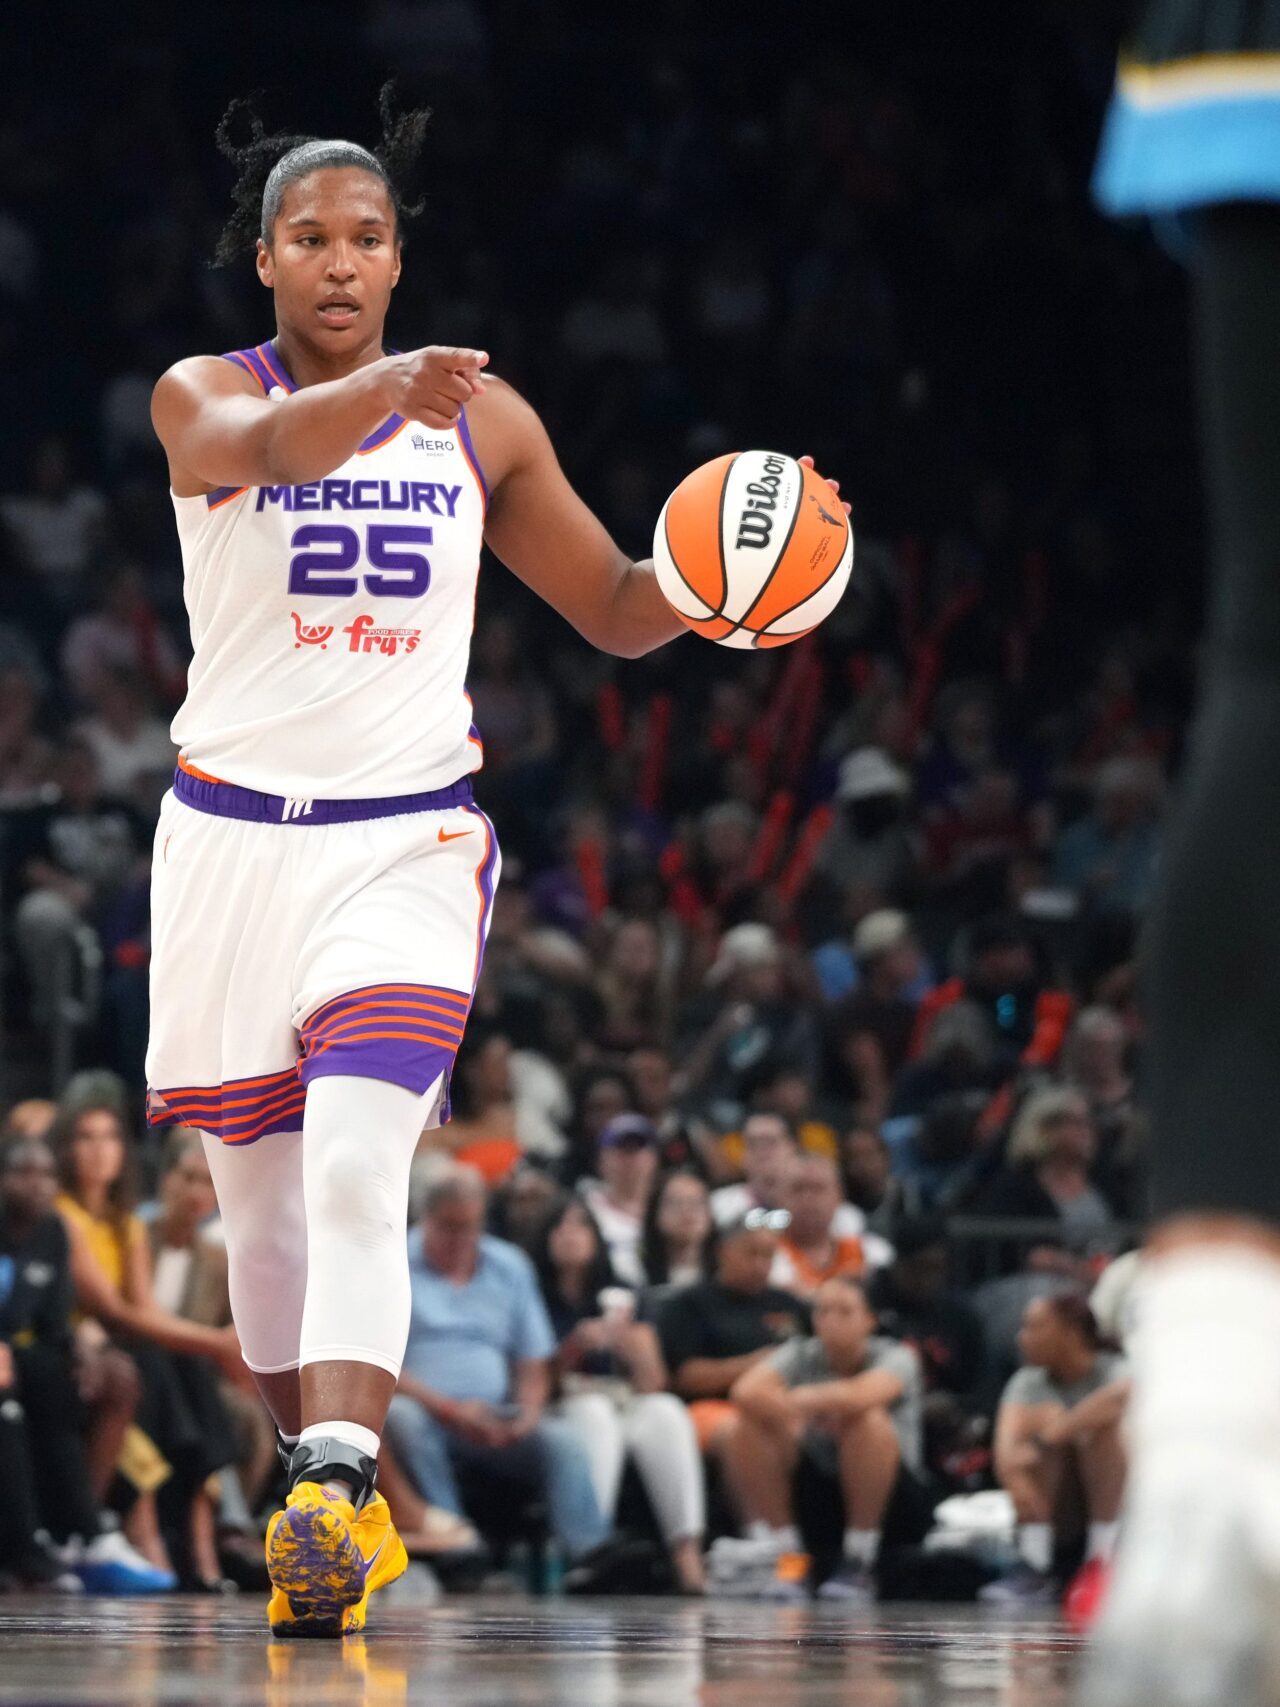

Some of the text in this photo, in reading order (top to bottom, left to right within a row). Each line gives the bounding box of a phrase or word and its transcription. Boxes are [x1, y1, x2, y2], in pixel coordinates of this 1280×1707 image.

[411, 439, 454, 451] HERO
[255, 479, 463, 518] MERCURY
[735, 455, 787, 550] Wilson
[287, 523, 433, 599] 25
